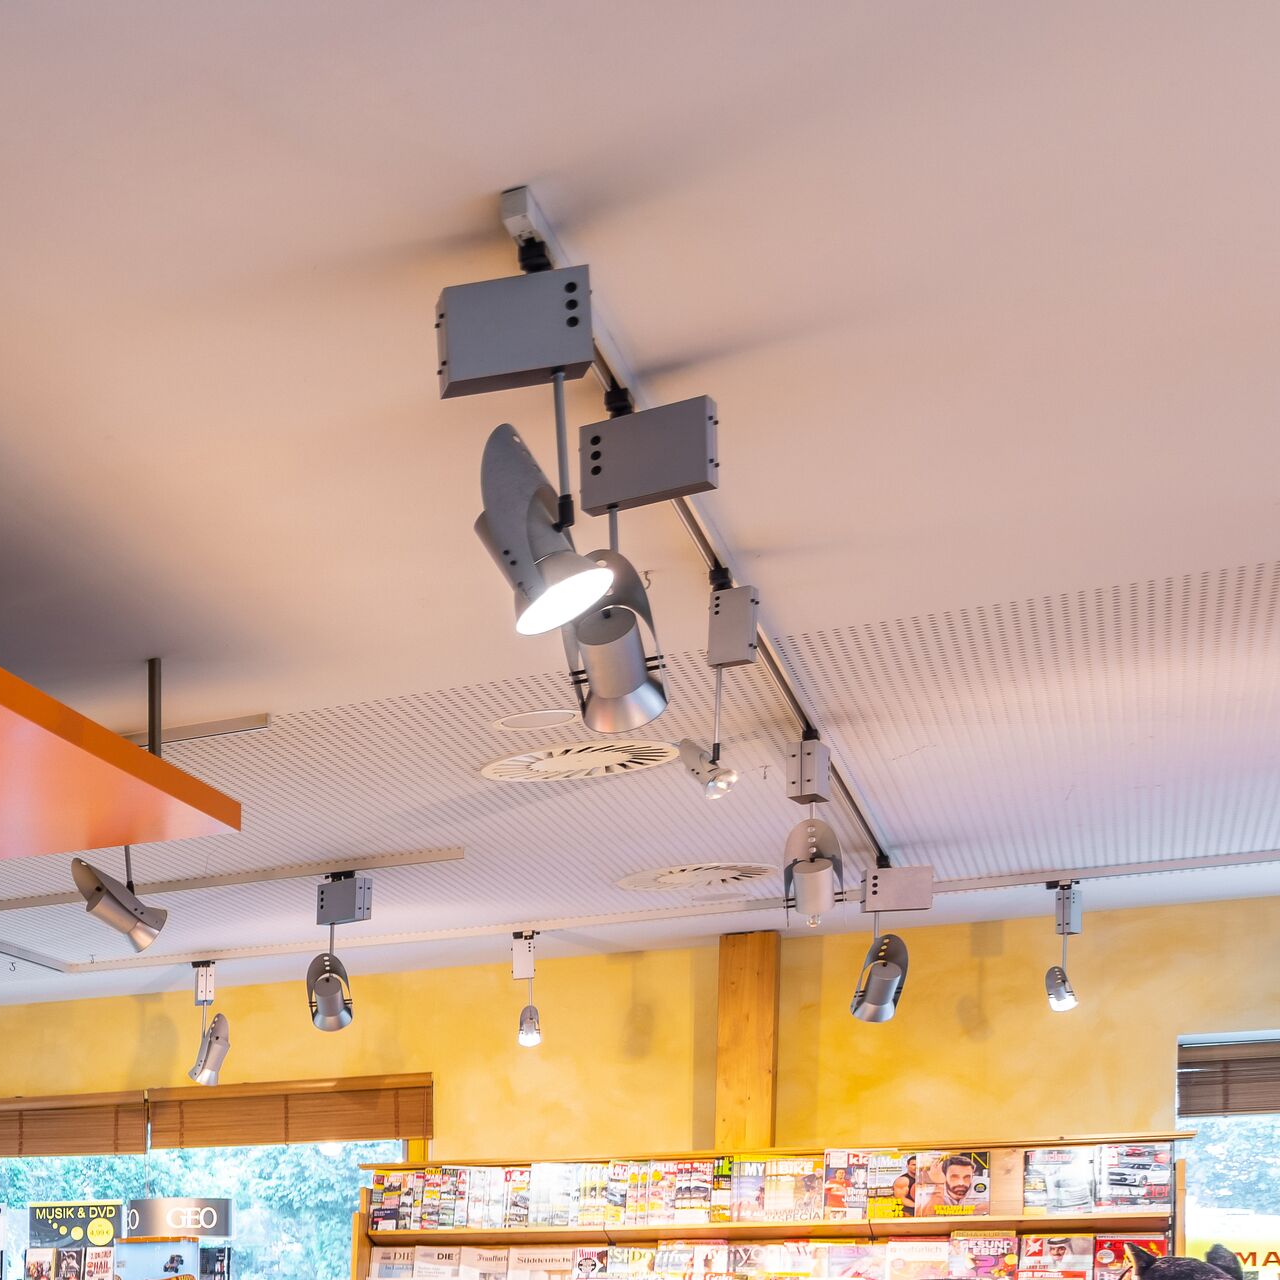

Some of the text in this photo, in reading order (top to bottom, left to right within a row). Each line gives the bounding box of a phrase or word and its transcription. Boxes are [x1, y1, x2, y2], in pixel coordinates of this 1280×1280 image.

[35, 1206, 116, 1219] MUSIK & DVD
[166, 1206, 217, 1229] GEO
[437, 1251, 454, 1260] DIE
